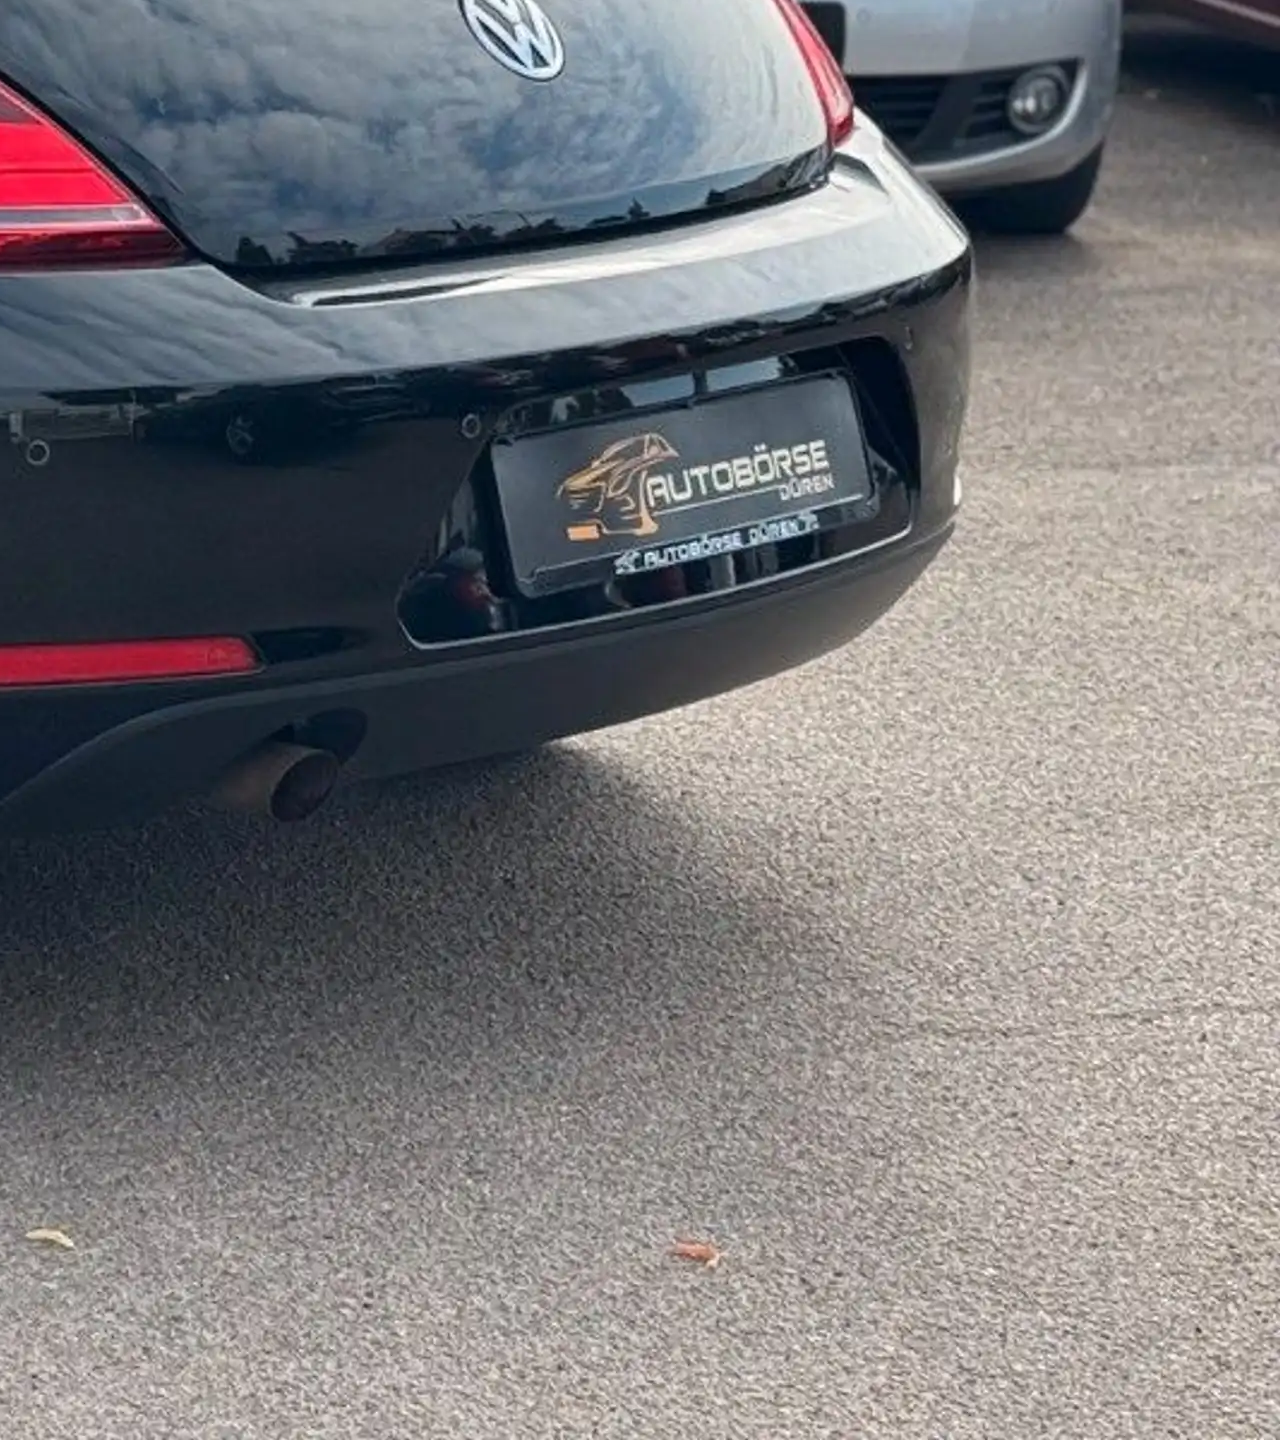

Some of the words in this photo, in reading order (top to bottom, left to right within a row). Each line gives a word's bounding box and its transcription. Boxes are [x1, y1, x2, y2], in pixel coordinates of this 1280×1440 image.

[646, 440, 830, 507] AUTOBÖRSE
[780, 473, 835, 501] DÜREN
[644, 532, 743, 569] AUTOBÖRSE
[748, 519, 800, 543] DÜREN
